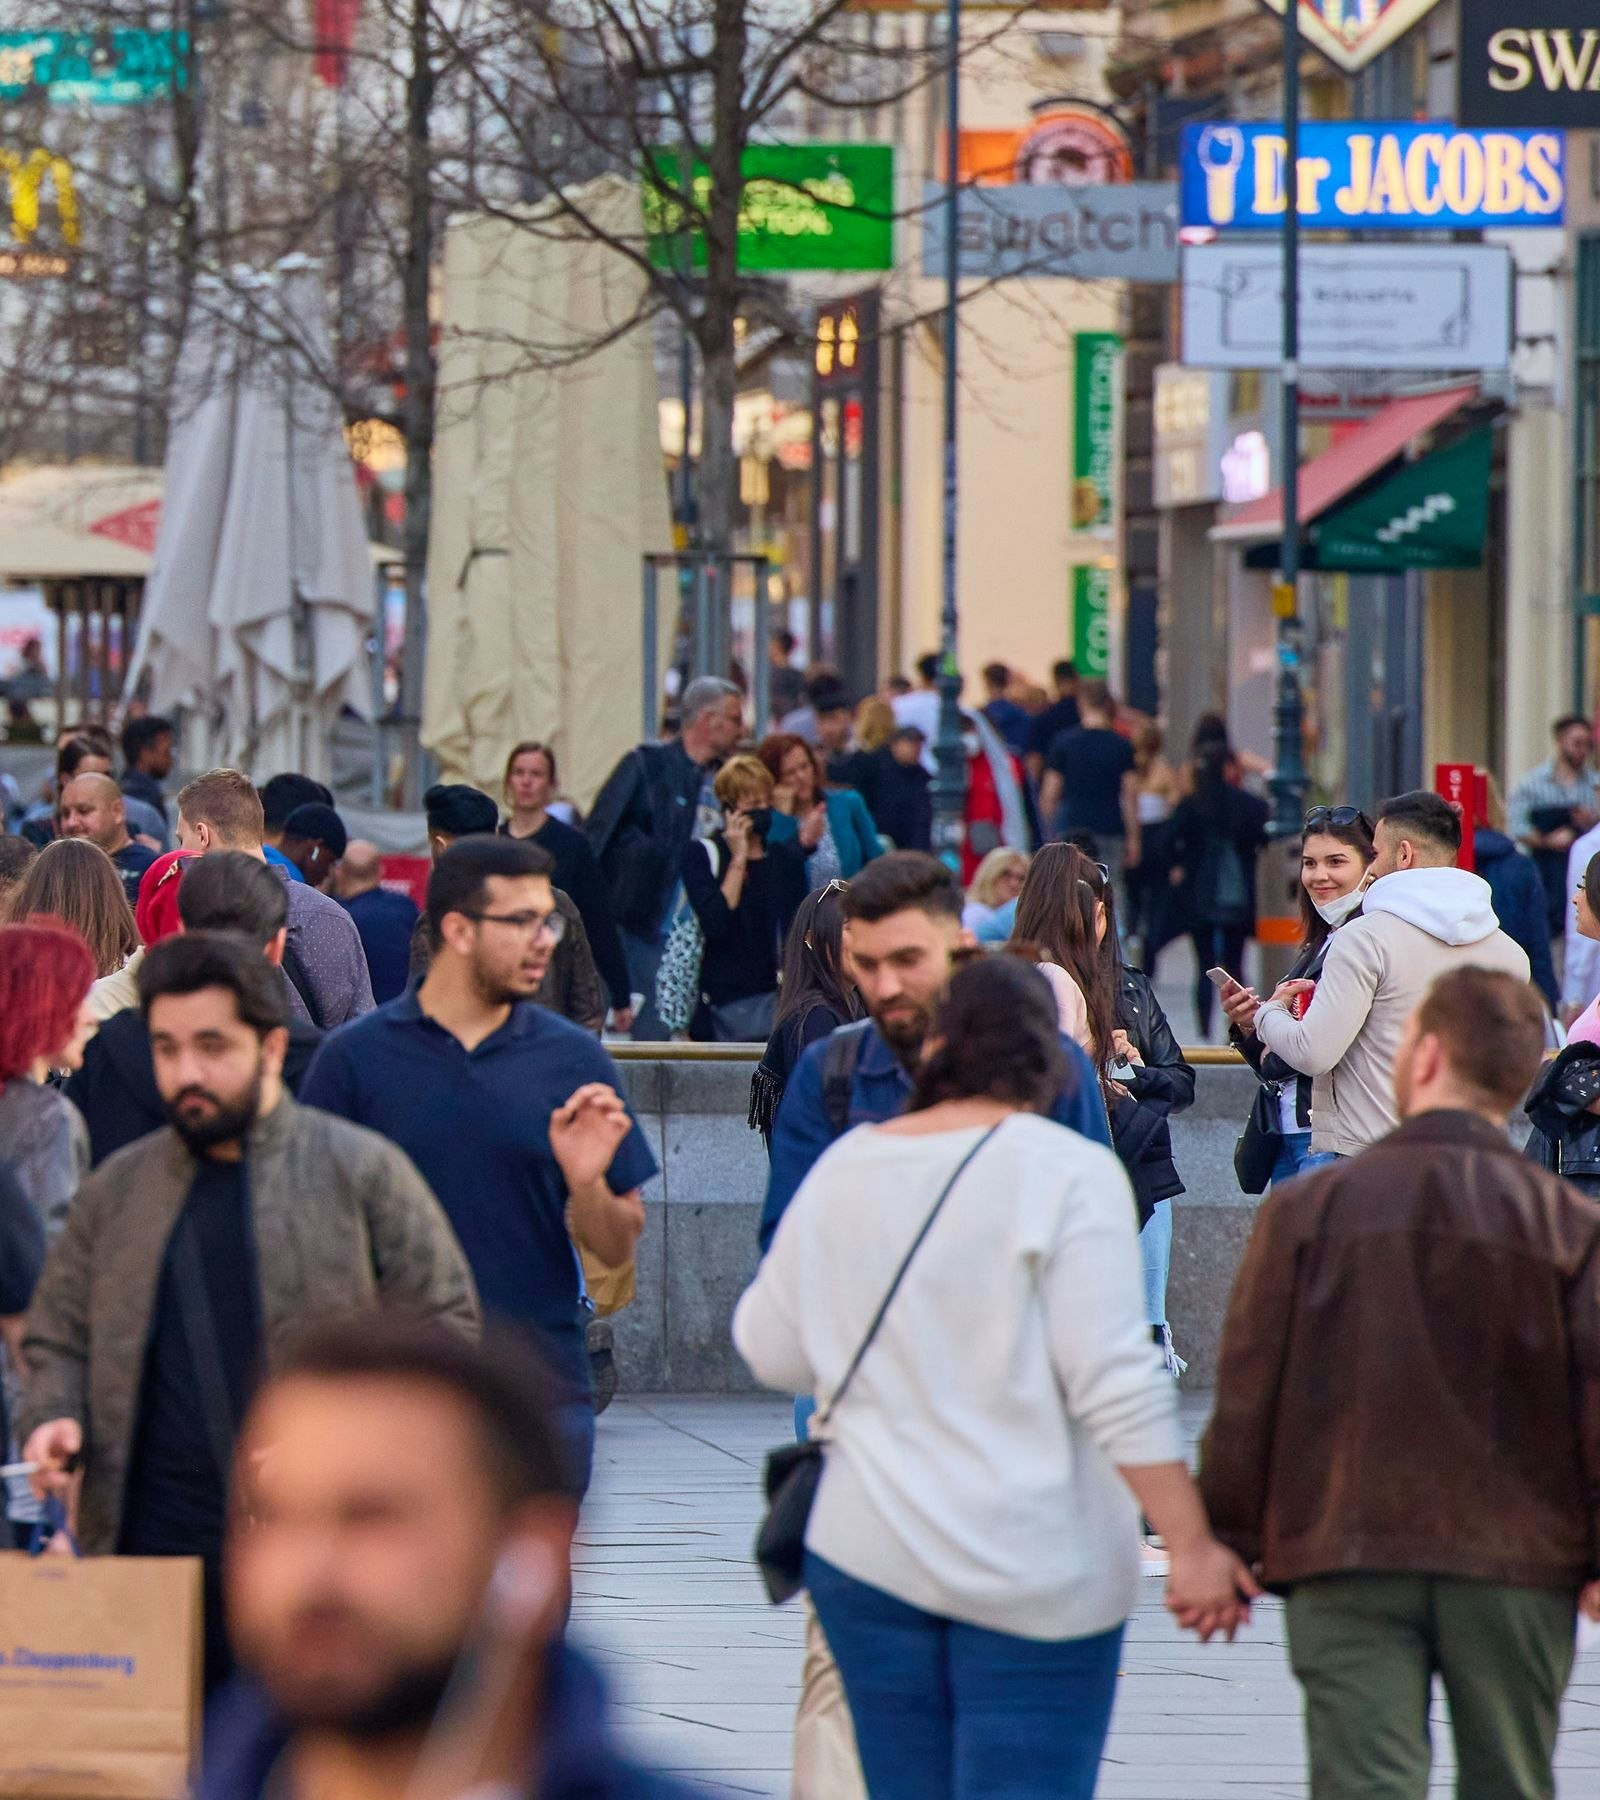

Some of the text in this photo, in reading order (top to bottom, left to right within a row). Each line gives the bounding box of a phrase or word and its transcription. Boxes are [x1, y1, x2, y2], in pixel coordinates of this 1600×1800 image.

[1487, 28, 1600, 92] SW
[1252, 133, 1563, 216] Dr JACOBS
